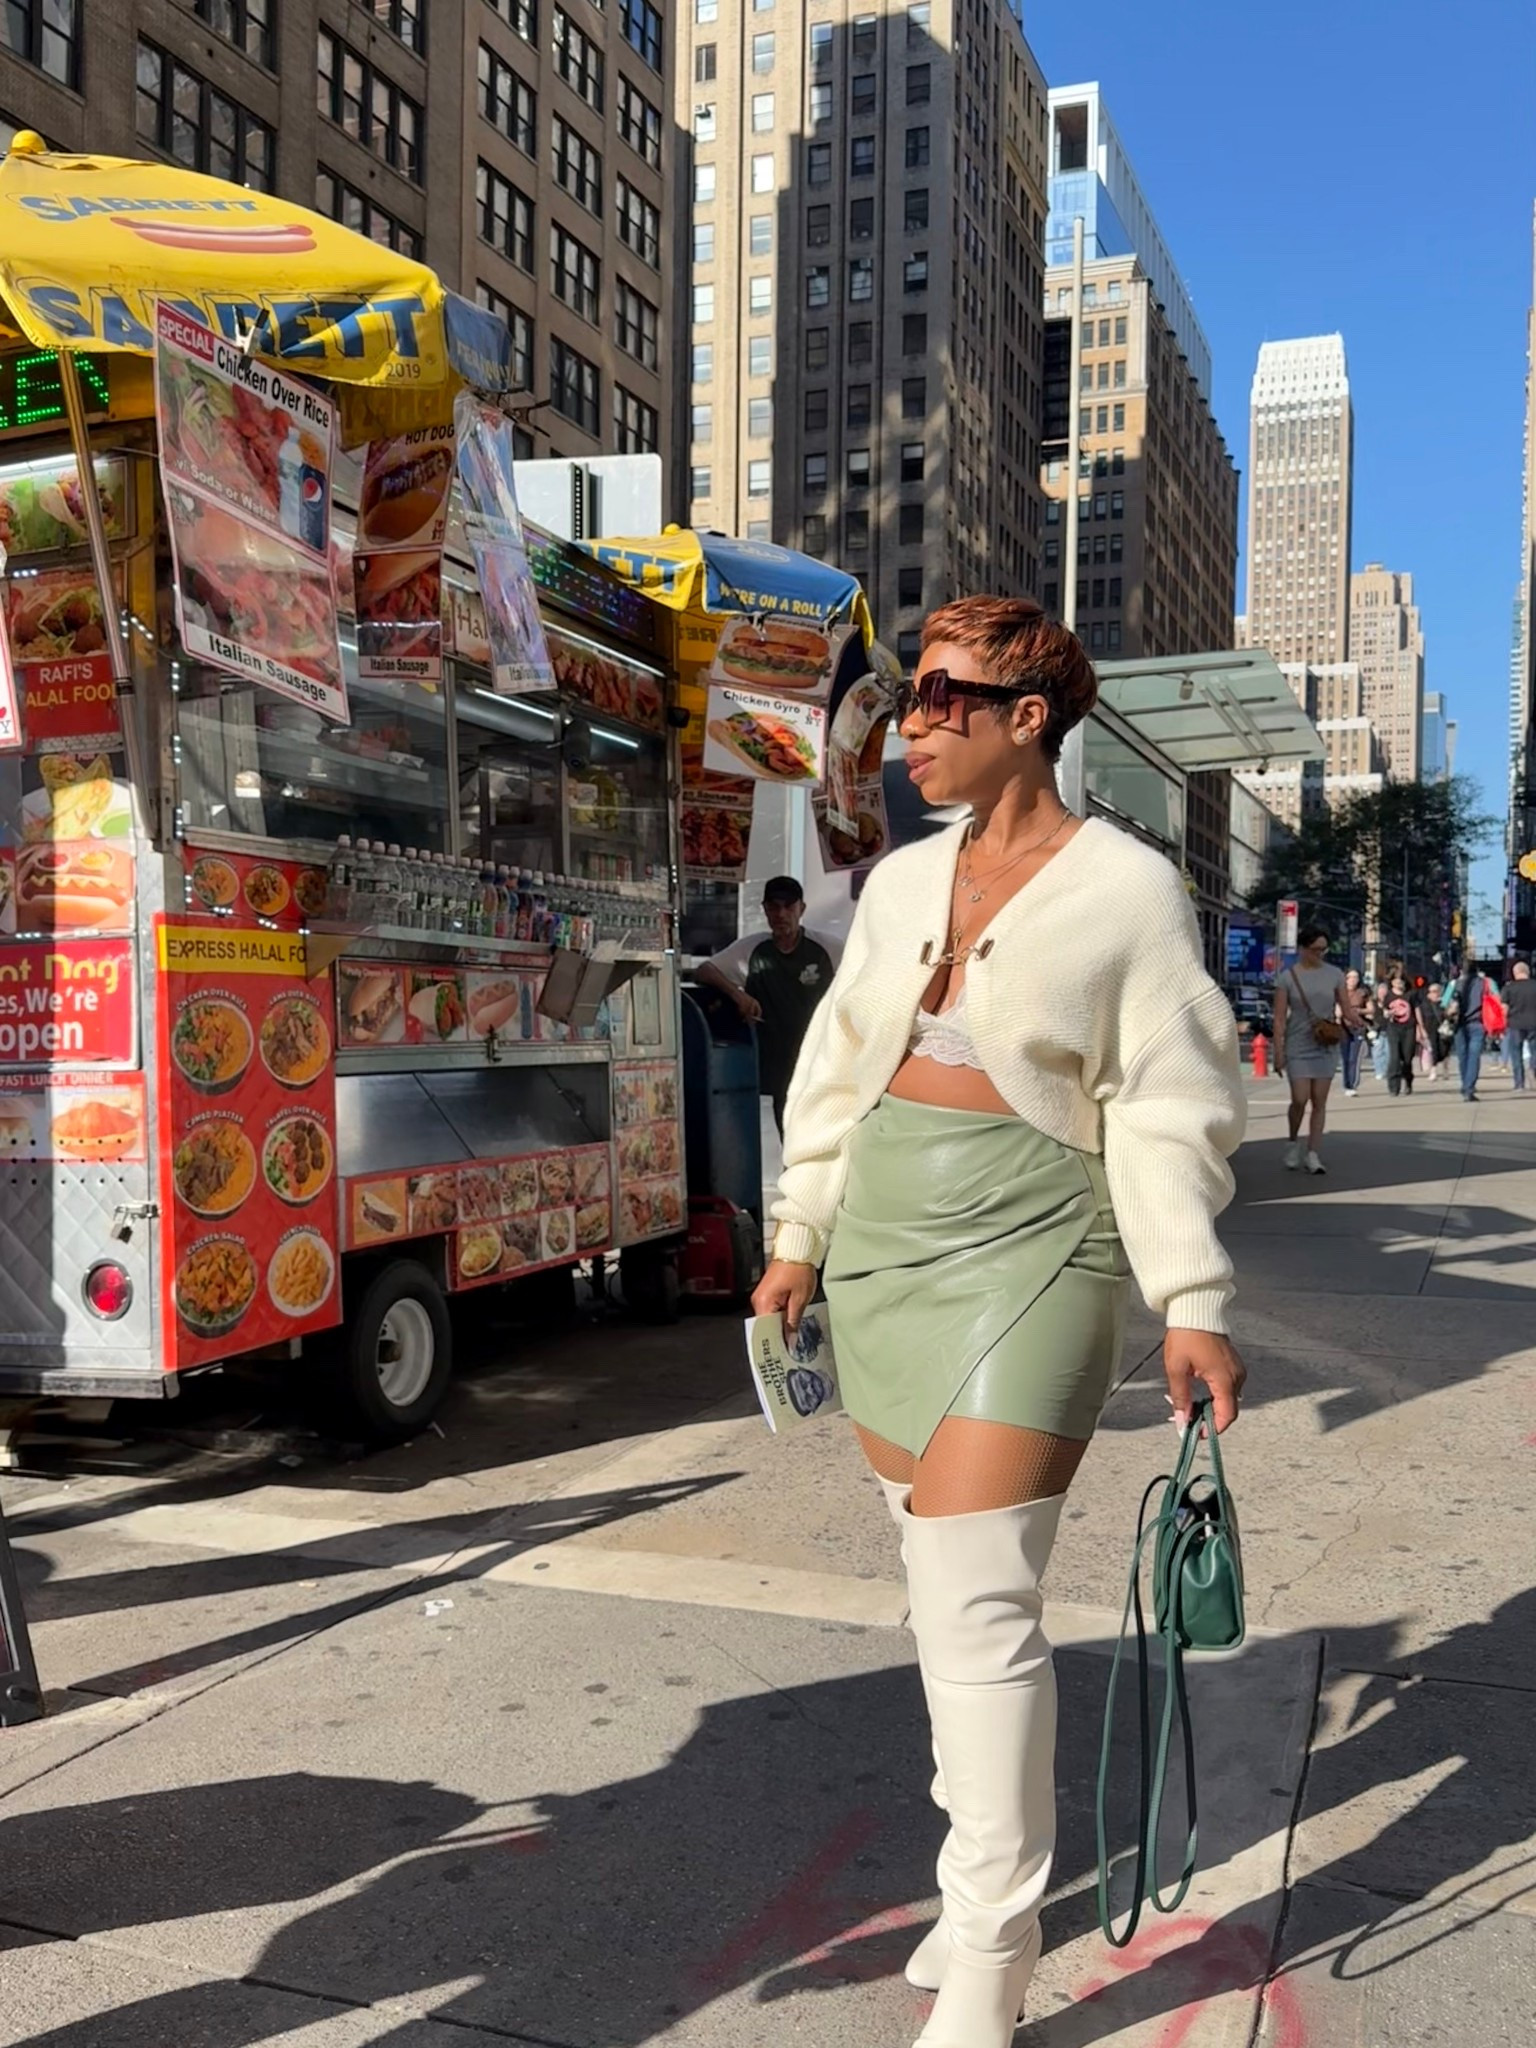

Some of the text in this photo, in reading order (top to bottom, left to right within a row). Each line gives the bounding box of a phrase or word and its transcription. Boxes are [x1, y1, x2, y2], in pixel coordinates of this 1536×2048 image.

[19, 195, 259, 222] SABRETT
[159, 315, 214, 356] SPECIAL
[388, 363, 421, 378] 2019
[217, 346, 330, 429] Chicken Over Rice
[405, 423, 455, 445] HOT DOG
[190, 464, 223, 493] Soda
[225, 485, 238, 500] or
[241, 491, 277, 523] Water
[759, 593, 778, 610] ON
[780, 598, 789, 612] A
[792, 599, 822, 618] ROLL
[40, 662, 93, 684] RAFI'S
[209, 634, 327, 701] Italian Sausage
[370, 657, 430, 675] Italian Sausage
[722, 690, 801, 715] Chicken Gyro
[167, 939, 236, 959] EXPRESS
[239, 942, 286, 962] HALAL
[210, 988, 230, 999] OVER
[0, 1020, 84, 1060] open
[757, 1361, 773, 1387] THE
[761, 1338, 788, 1406] BROTHERS
